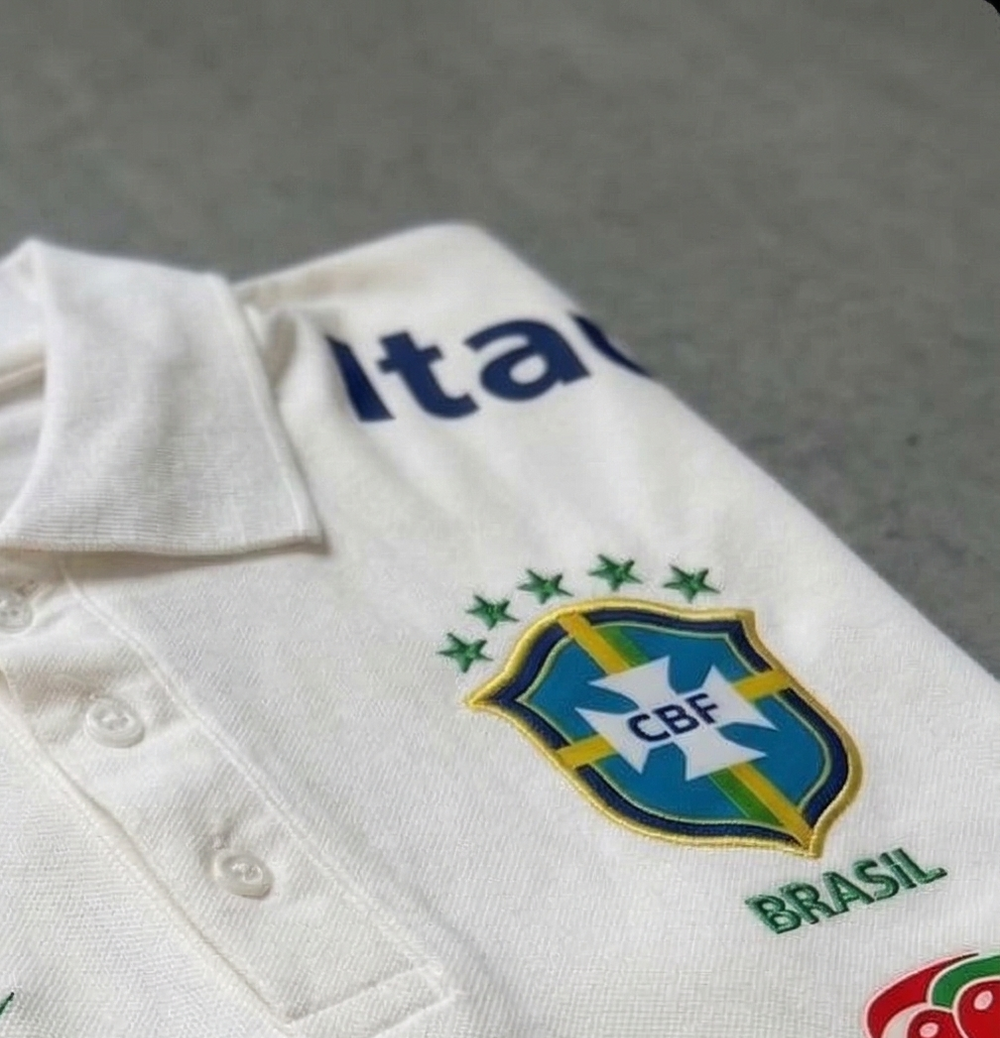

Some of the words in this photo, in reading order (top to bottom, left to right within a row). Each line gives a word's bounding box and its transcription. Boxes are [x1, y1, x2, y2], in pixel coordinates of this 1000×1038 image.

[325, 311, 653, 422] Ita
[628, 693, 719, 742] CBF
[744, 847, 948, 934] BRASIL
